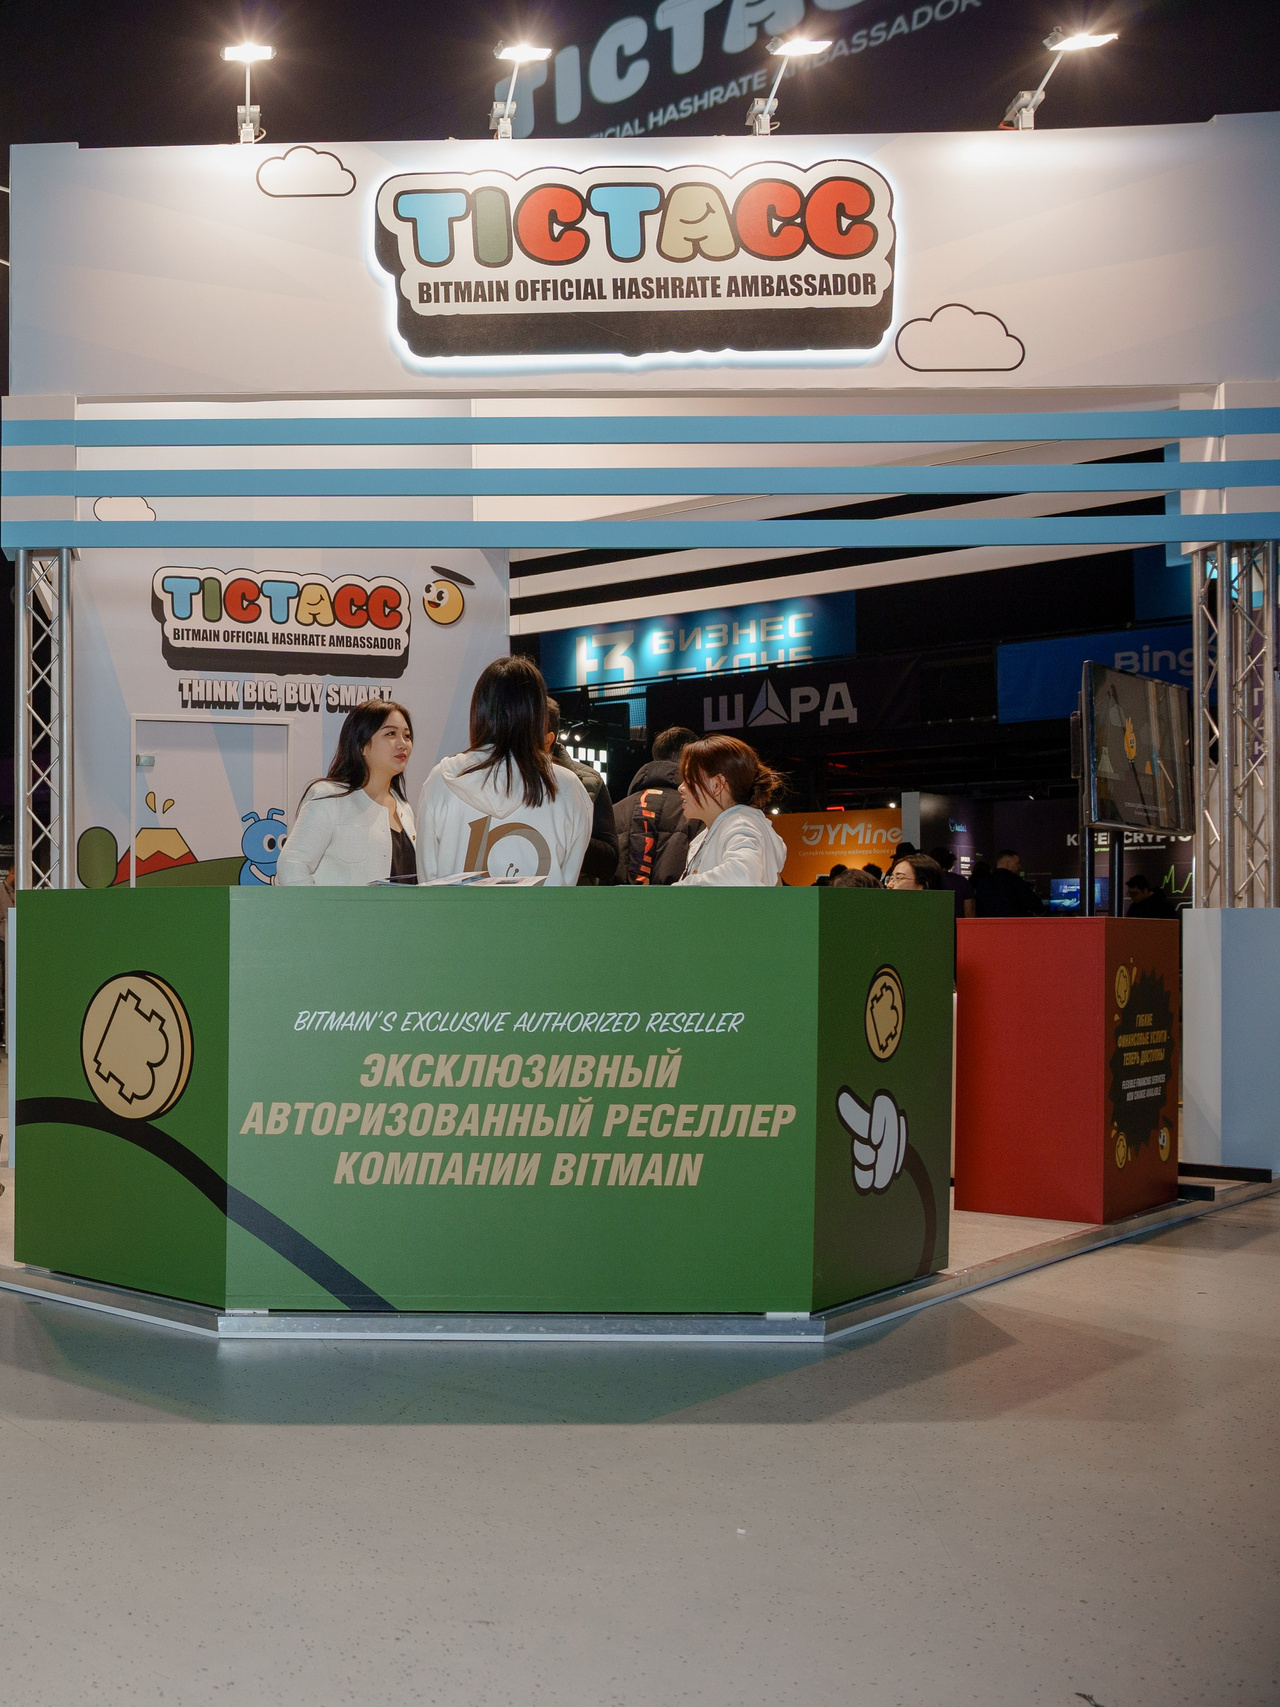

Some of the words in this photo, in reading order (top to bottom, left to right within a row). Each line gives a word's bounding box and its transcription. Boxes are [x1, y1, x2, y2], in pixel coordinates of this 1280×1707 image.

[648, 70, 767, 130] HASHRATE
[394, 176, 878, 268] TICTACC
[418, 280, 510, 304] BITMAIN
[515, 278, 607, 302] OFFICIAL
[612, 275, 721, 300] HASHRATE
[725, 272, 876, 298] AMBASSADOR
[162, 576, 403, 631] TICTACC
[173, 627, 220, 643] BITMAIN
[222, 629, 270, 645] OFFICIAL
[272, 632, 327, 647] HASHRATE
[328, 634, 402, 651] AMBASSADOR
[652, 612, 813, 655] БИЗНЕС
[179, 678, 240, 707] THINK
[243, 679, 282, 708] BIG,
[284, 682, 323, 709] BUY
[293, 1010, 397, 1033] BITMAIN'S
[400, 1011, 512, 1033] EXCLUSIVE
[513, 1011, 641, 1034] AUTHORIZED
[645, 1012, 745, 1034] RESELLER
[360, 1047, 683, 1089] ЭКСКЛЮЗИВНЫЙ
[239, 1096, 594, 1137] АВТОРИЗОВАННЫЙ
[602, 1103, 797, 1138] РЕСЕЛЛЕР
[333, 1151, 542, 1186] КОМПАНИИ
[549, 1153, 704, 1187] BITMAIN
